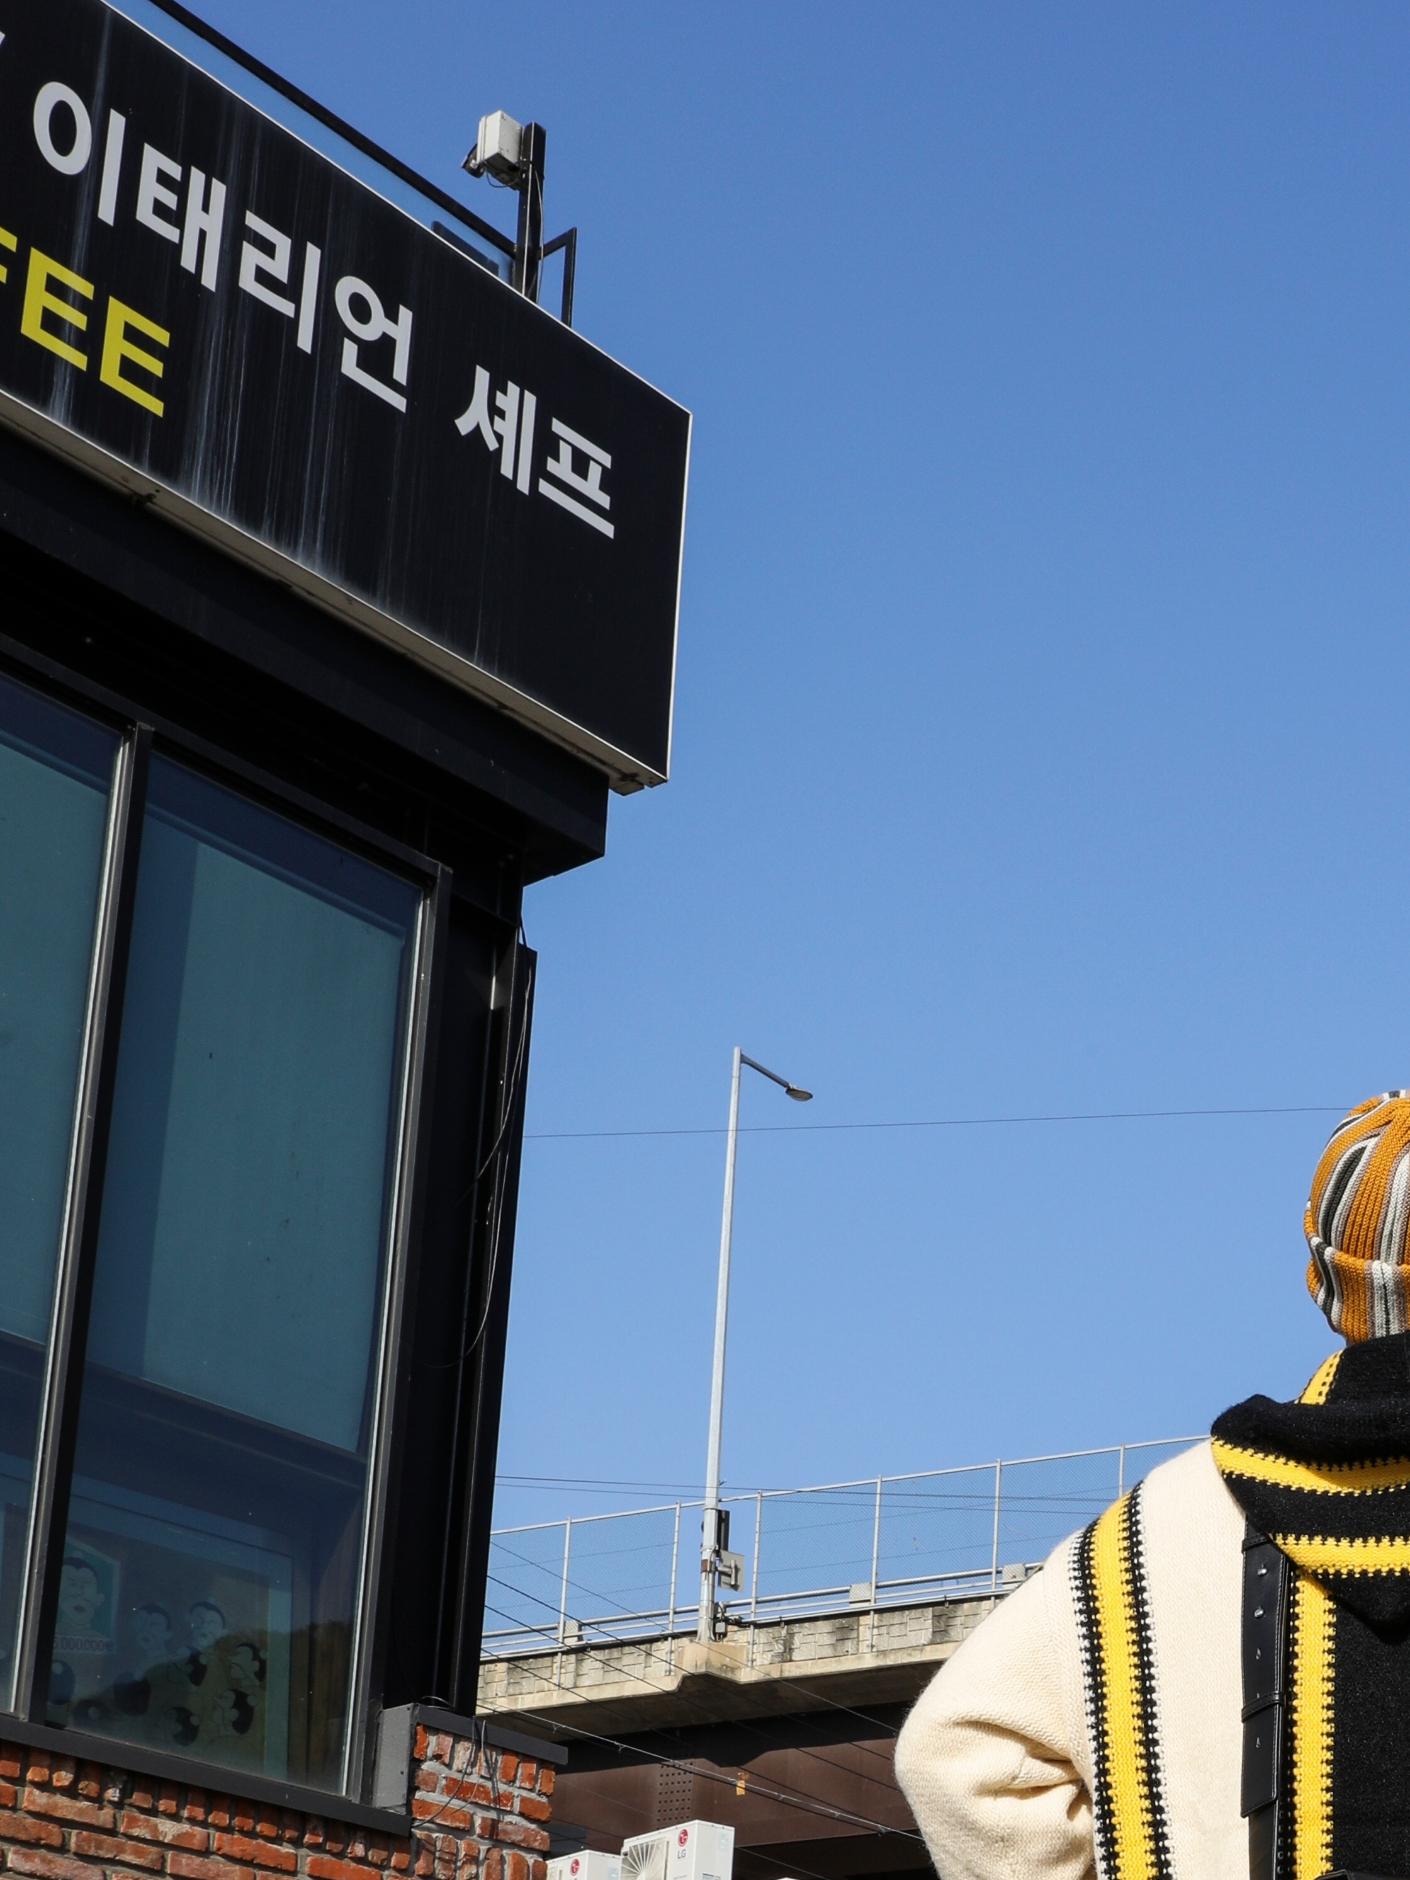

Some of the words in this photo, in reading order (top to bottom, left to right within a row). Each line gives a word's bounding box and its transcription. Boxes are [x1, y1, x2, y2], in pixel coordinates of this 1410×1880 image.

[0, 226, 171, 418] EE
[34, 81, 413, 414] 이태리언
[454, 364, 615, 540] 셰프
[677, 1849, 687, 1859] LG
